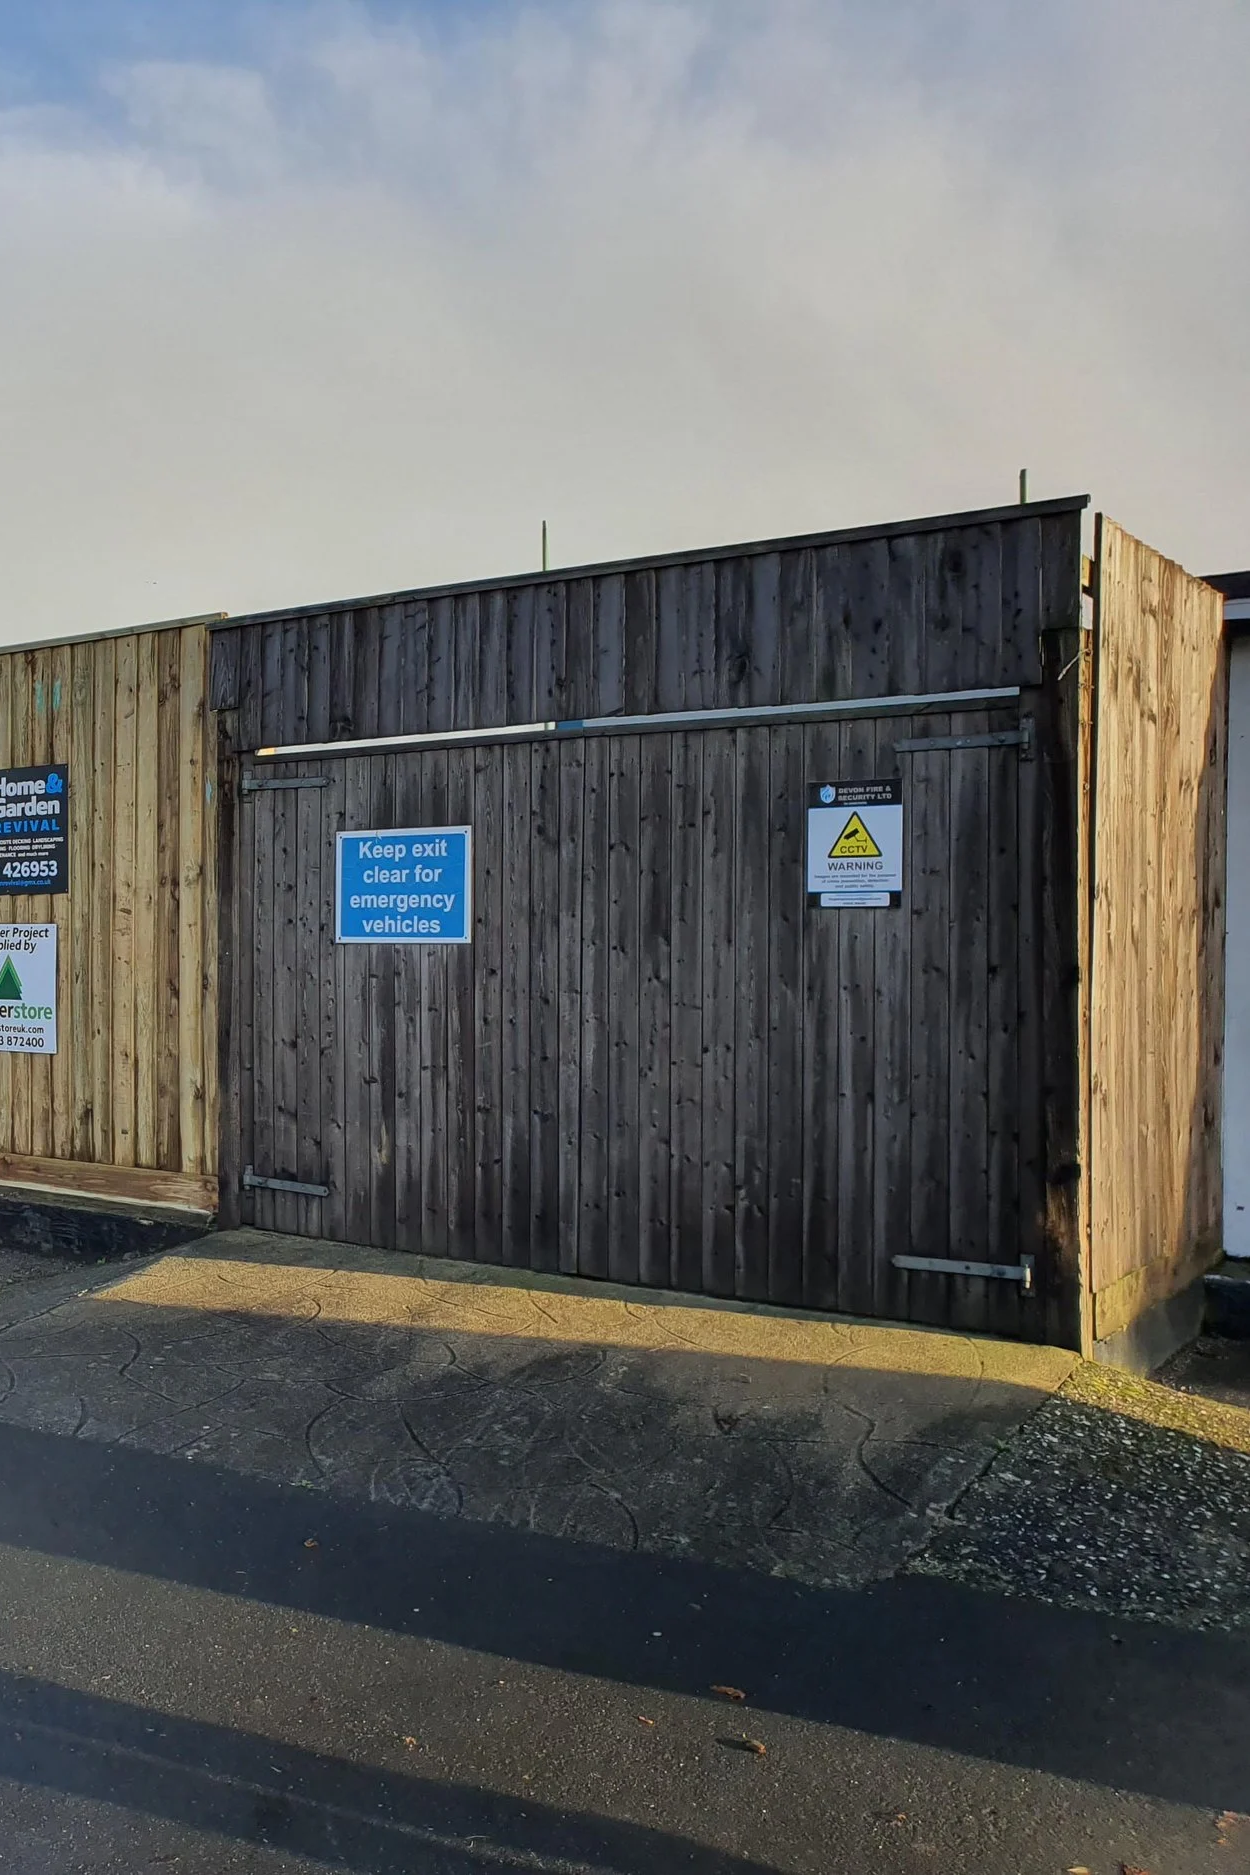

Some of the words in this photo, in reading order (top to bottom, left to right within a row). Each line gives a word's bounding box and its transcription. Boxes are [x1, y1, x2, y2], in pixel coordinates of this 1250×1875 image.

[359, 840, 406, 861] Keep
[412, 839, 448, 857] exit
[840, 845, 868, 854] CCTV
[3, 860, 58, 878] 426953
[364, 866, 410, 884] clear
[414, 864, 442, 882] for
[827, 862, 883, 871] WARNING
[350, 894, 455, 912] emergency
[362, 916, 441, 933] vehicles
[12, 928, 49, 941] Project
[24, 940, 37, 953] by
[7, 1037, 44, 1048] 872400
